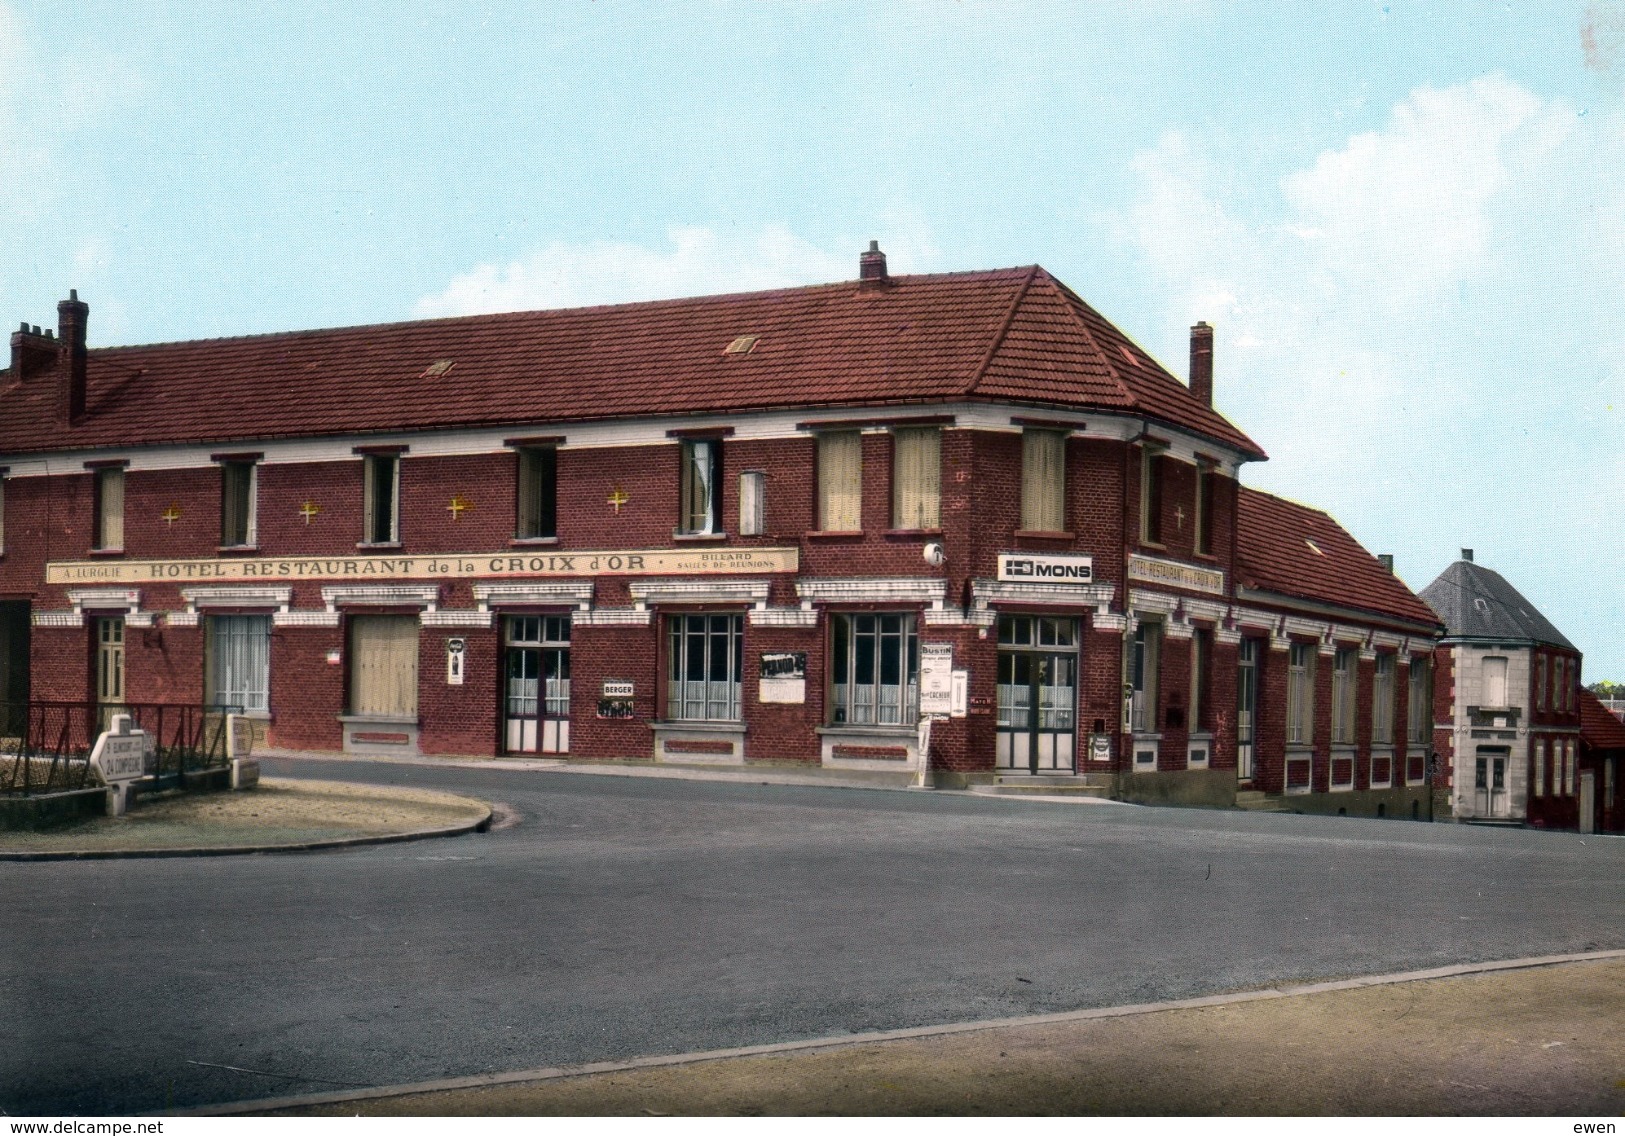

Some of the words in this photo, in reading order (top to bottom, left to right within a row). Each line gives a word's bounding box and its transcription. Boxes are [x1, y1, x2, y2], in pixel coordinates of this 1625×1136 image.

[702, 553, 752, 562] BILLARD
[243, 560, 414, 576] RESTAURANT
[428, 559, 449, 573] de
[458, 559, 475, 572] la
[489, 556, 575, 571] CROIX
[590, 555, 645, 570] d'OR
[1036, 565, 1091, 578] MONS
[922, 646, 951, 654] BUSTIN
[605, 686, 632, 694] BERGER
[106, 758, 114, 776] 24
